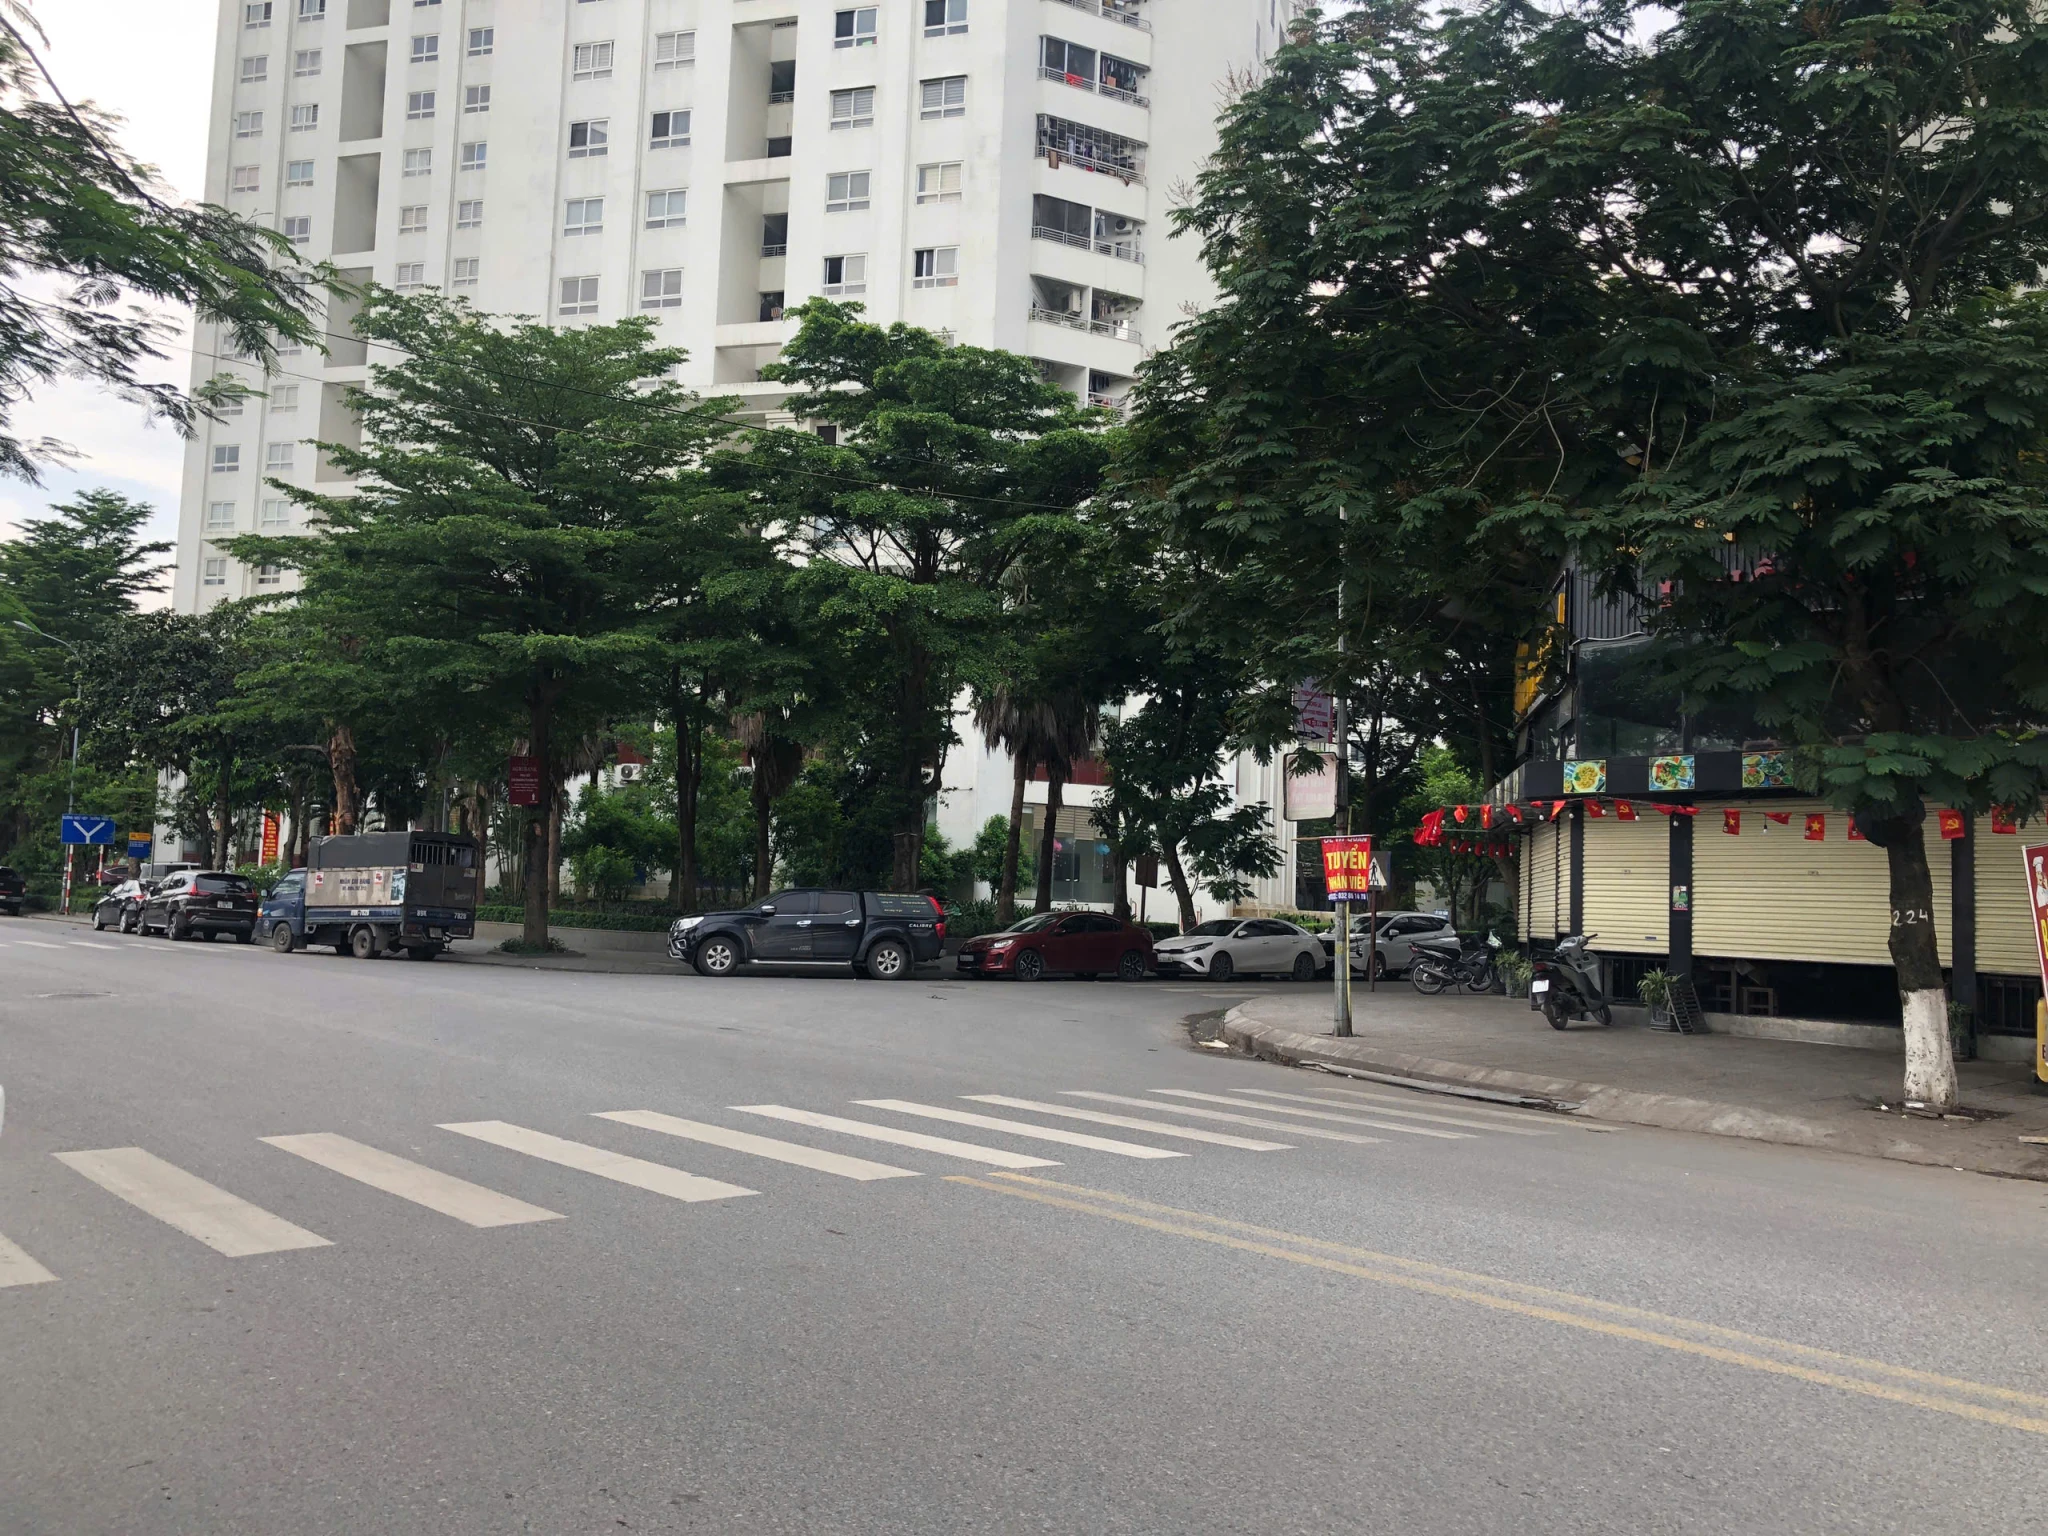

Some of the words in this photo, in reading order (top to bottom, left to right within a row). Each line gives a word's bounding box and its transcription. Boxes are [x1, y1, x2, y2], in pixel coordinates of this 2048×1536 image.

[1325, 843, 1367, 870] TUYỂN
[1349, 873, 1367, 890] VIÊN
[1892, 908, 1929, 927] 224
